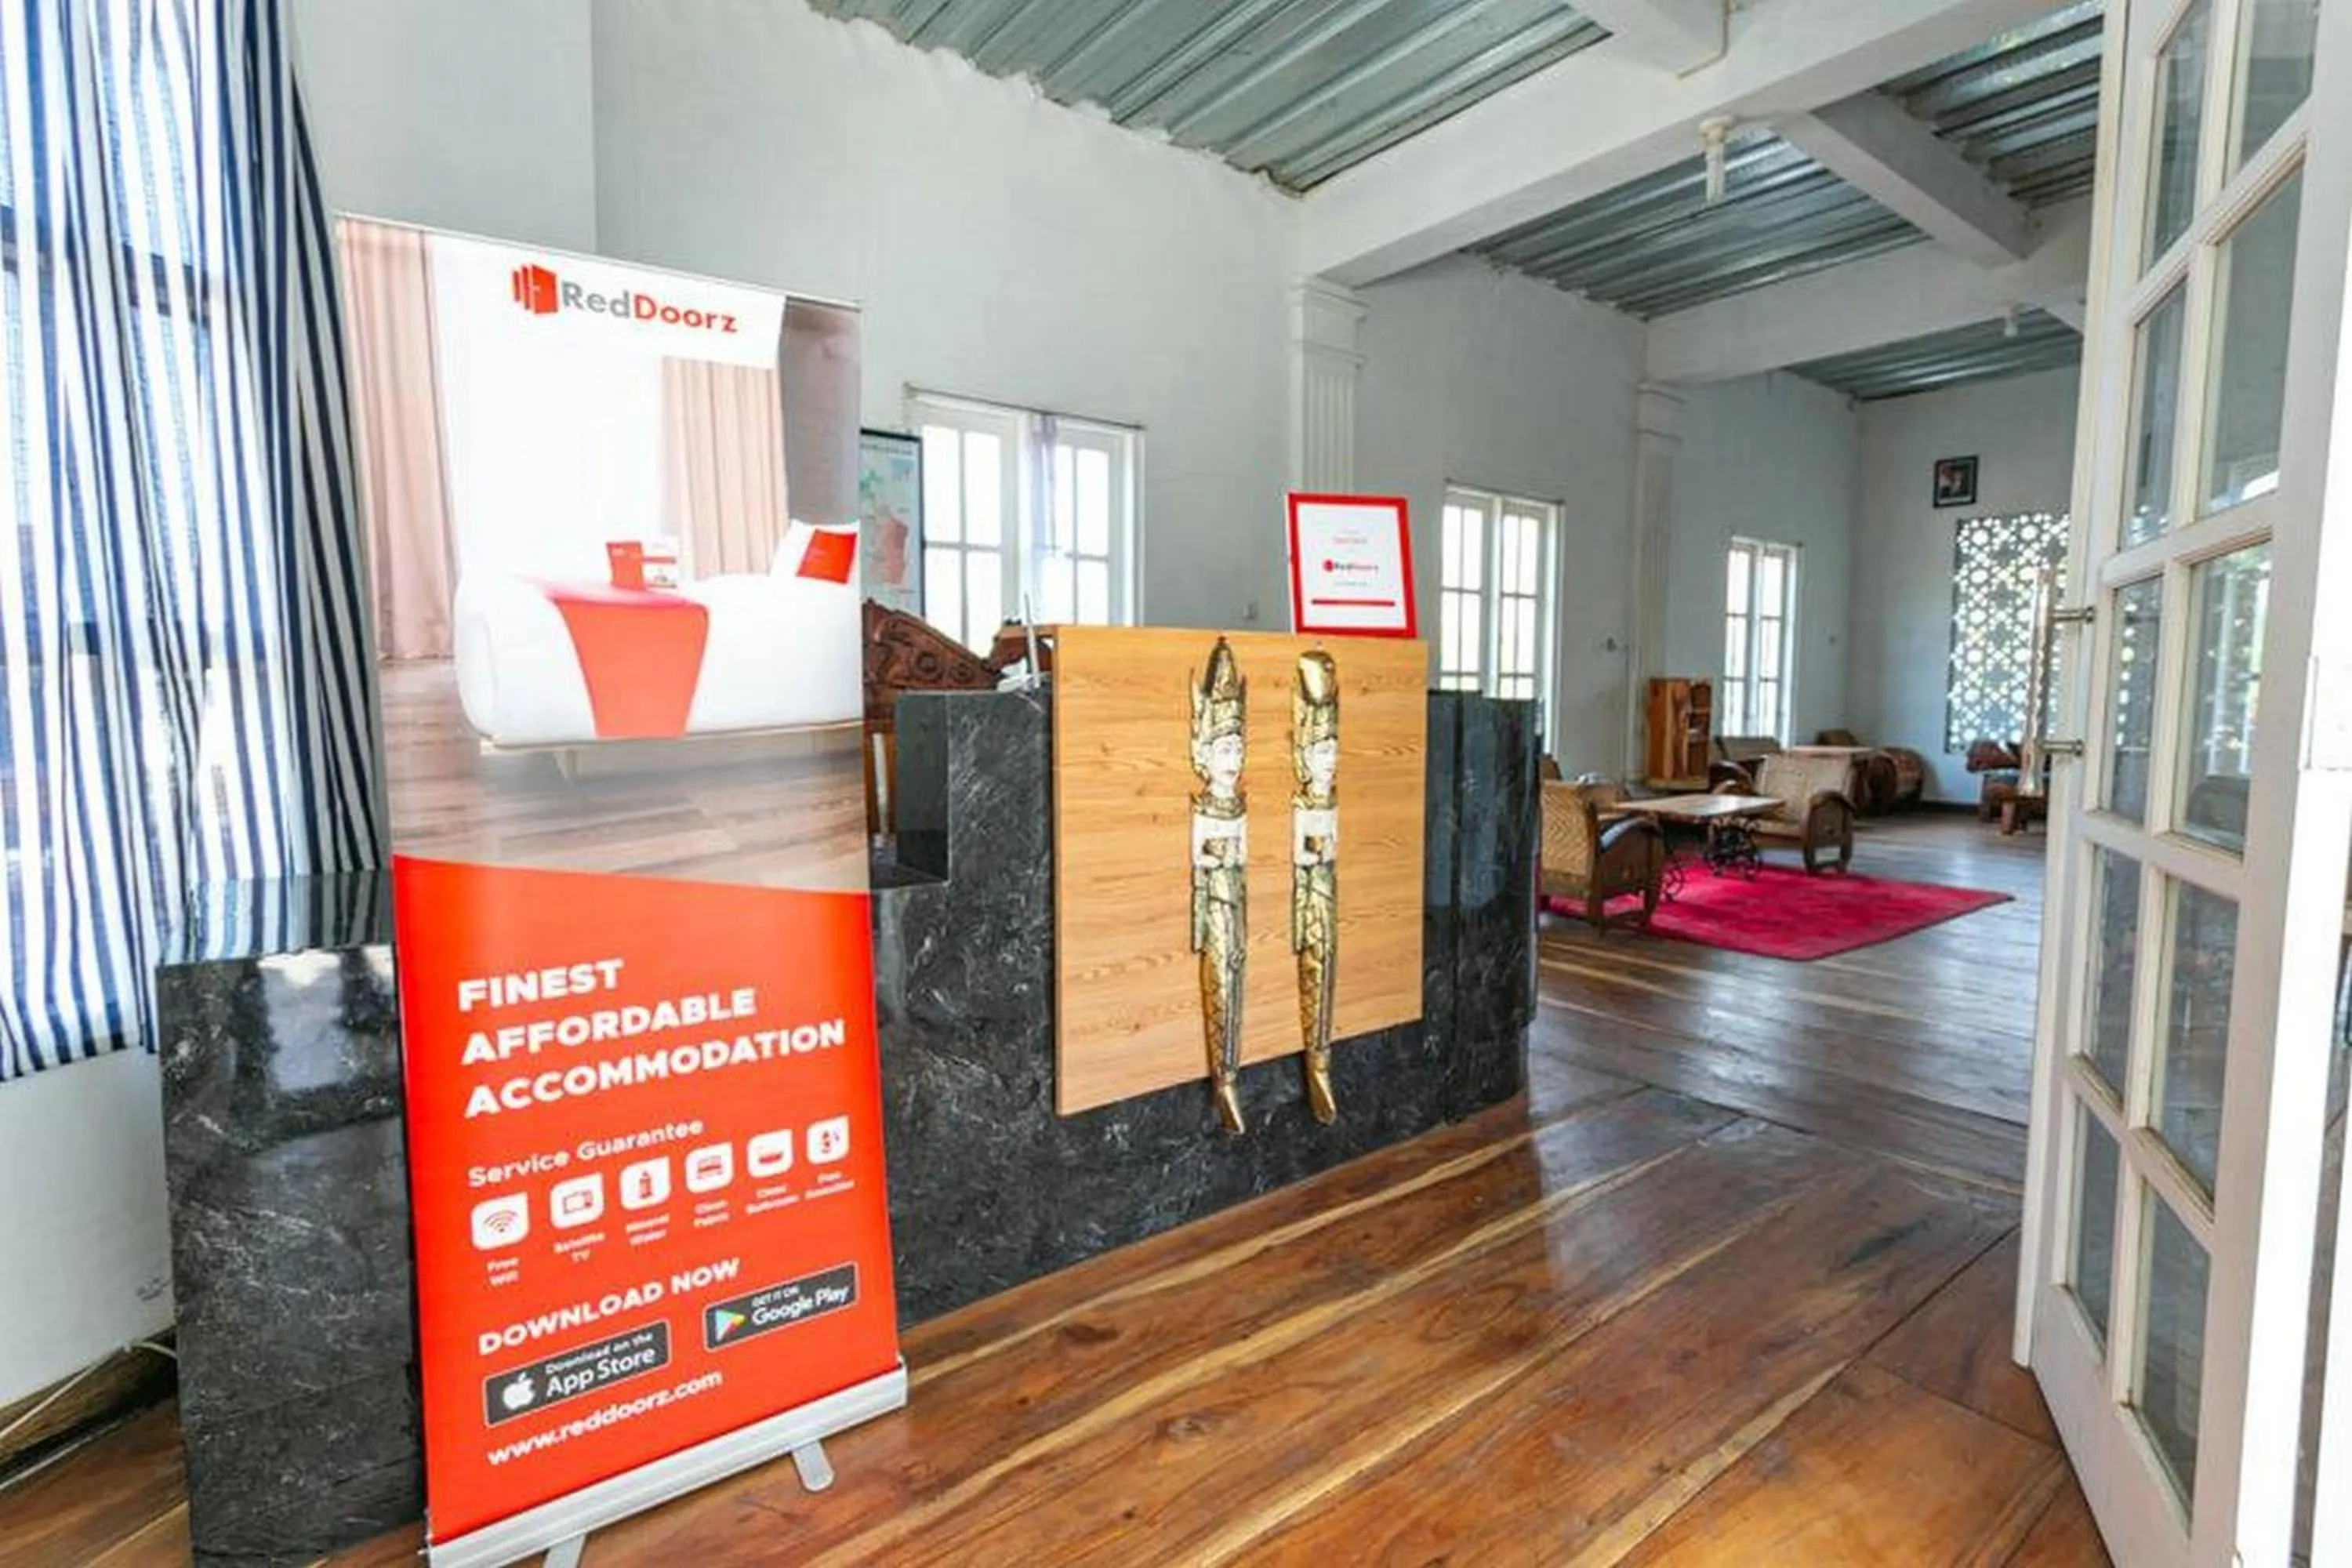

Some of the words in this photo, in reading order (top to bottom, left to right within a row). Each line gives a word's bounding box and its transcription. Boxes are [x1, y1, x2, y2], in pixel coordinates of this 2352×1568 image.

[561, 281, 739, 334] RedDoorz
[459, 958, 624, 1012] FINEST
[461, 988, 757, 1065] AFFORDABLE
[464, 1018, 846, 1119] ACCOMMODATION
[467, 1151, 570, 1187] Service
[576, 1120, 704, 1160] Guarantee
[478, 1282, 663, 1356] DOWNLOAD
[670, 1258, 742, 1295] NOW
[751, 1295, 814, 1327] Google
[815, 1286, 850, 1307] Play
[544, 1342, 612, 1375] Download
[546, 1368, 595, 1398] App
[597, 1348, 656, 1380] Store
[487, 1371, 724, 1466] www.reddoorz.com
